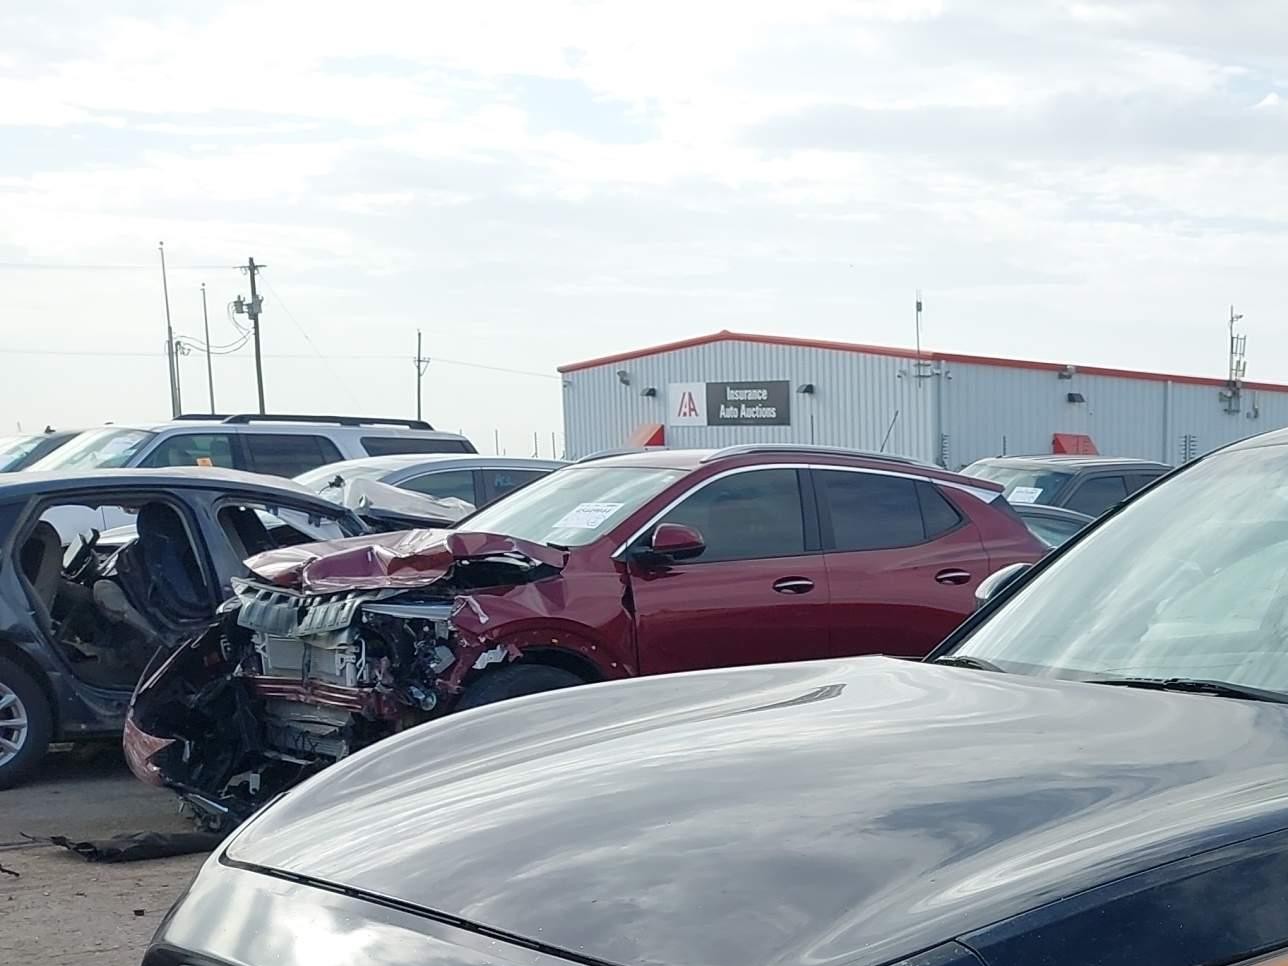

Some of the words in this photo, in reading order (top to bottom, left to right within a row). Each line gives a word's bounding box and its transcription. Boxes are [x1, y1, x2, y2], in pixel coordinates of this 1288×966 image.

[726, 386, 768, 401] Insurance
[719, 404, 738, 419] Auto
[740, 403, 777, 419] Auctions
